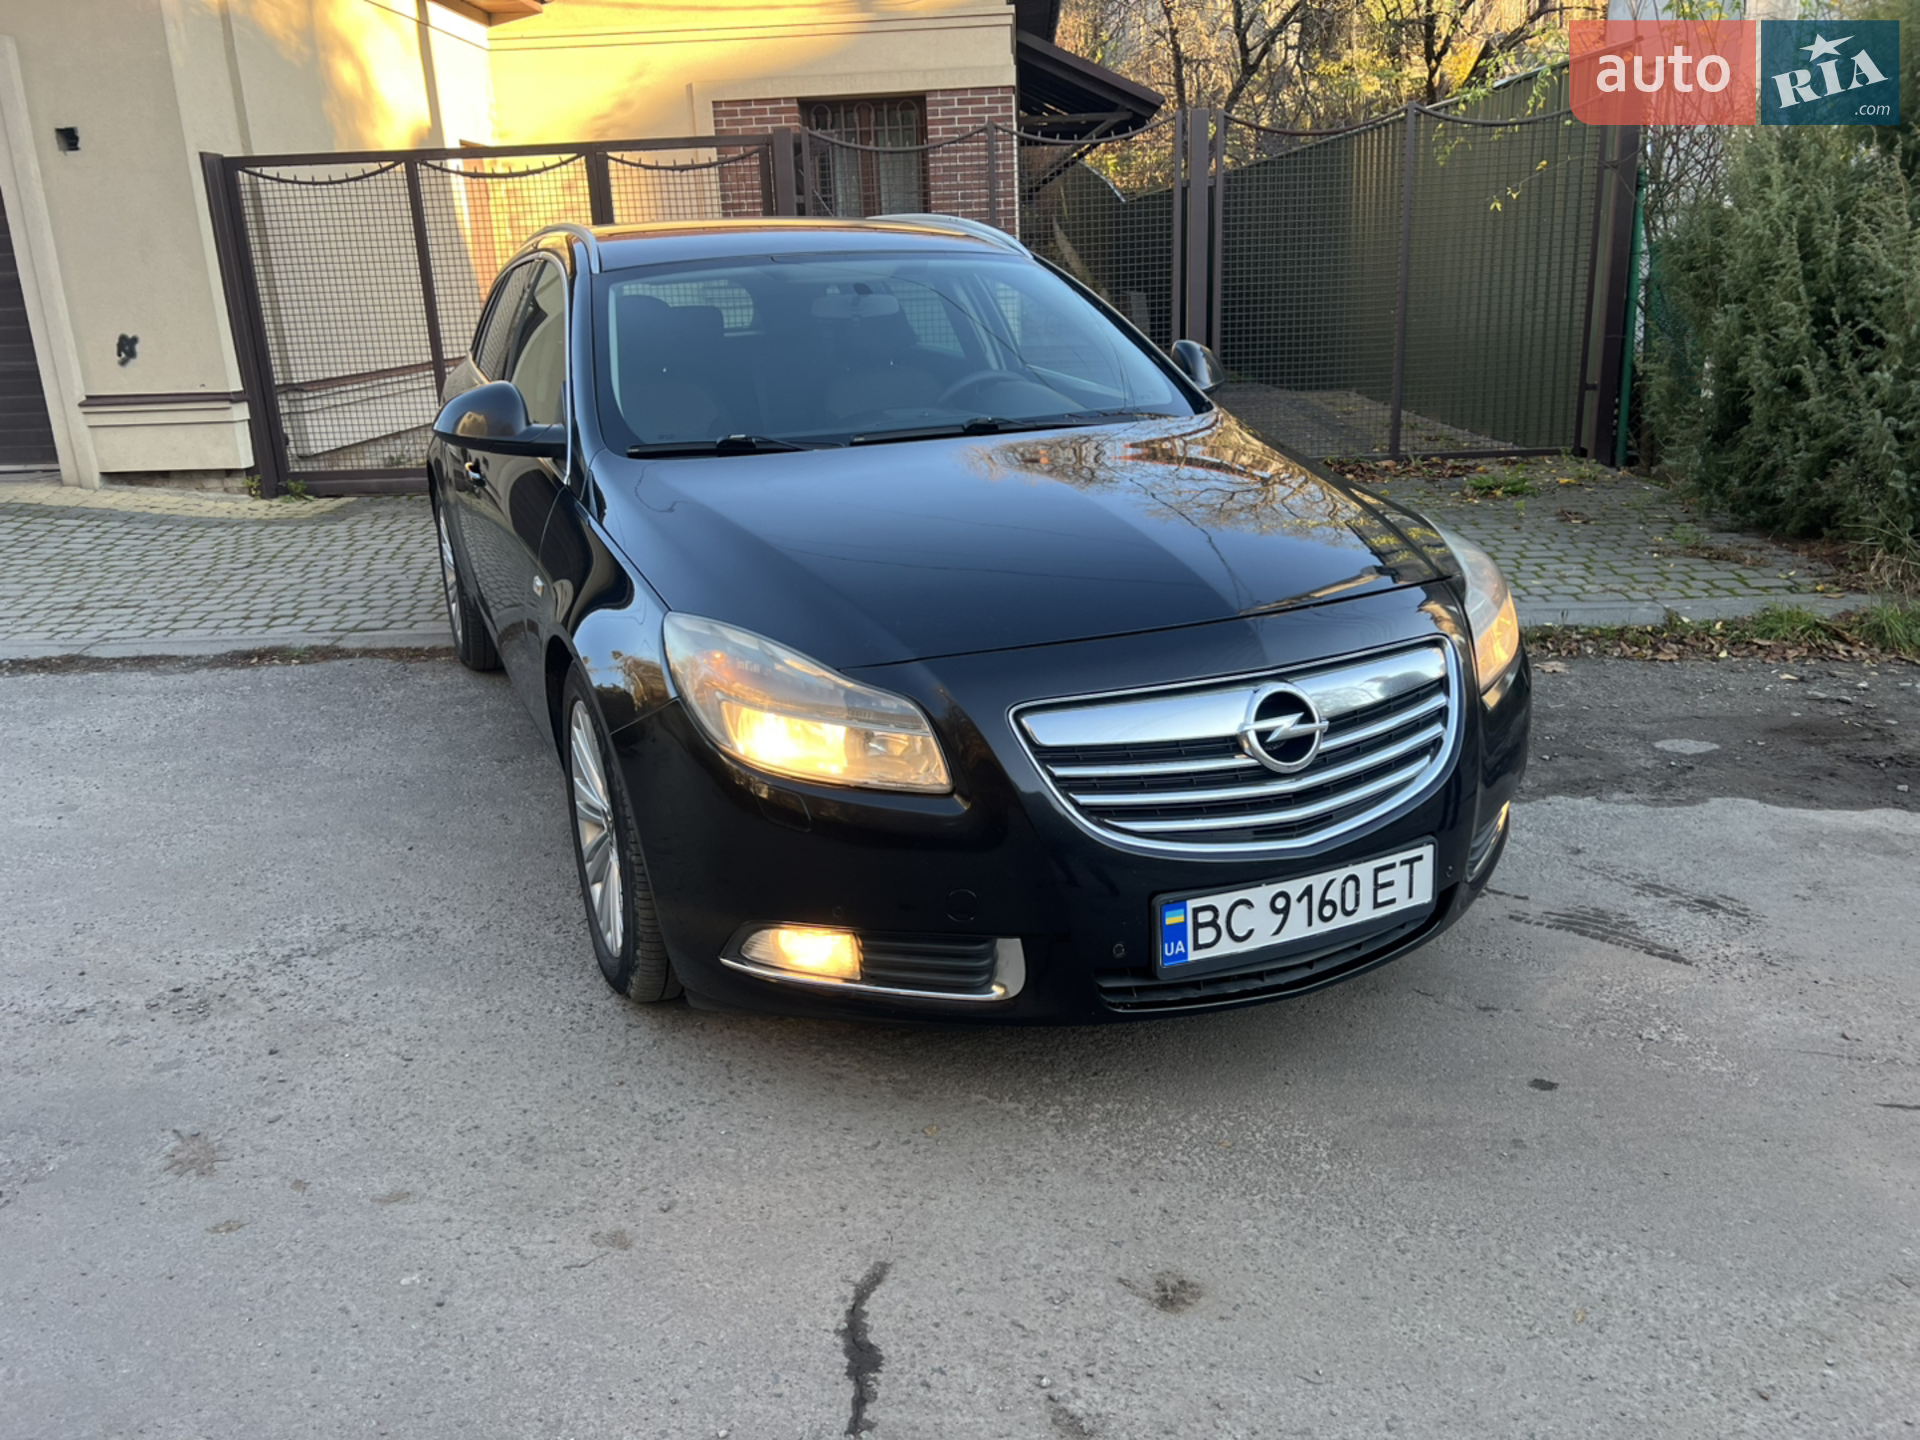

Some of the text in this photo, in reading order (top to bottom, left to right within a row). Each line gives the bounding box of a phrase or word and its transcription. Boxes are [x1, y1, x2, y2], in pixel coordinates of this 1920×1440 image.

[1191, 854, 1424, 952] BC 9160 ET
[1164, 940, 1186, 956] UA
